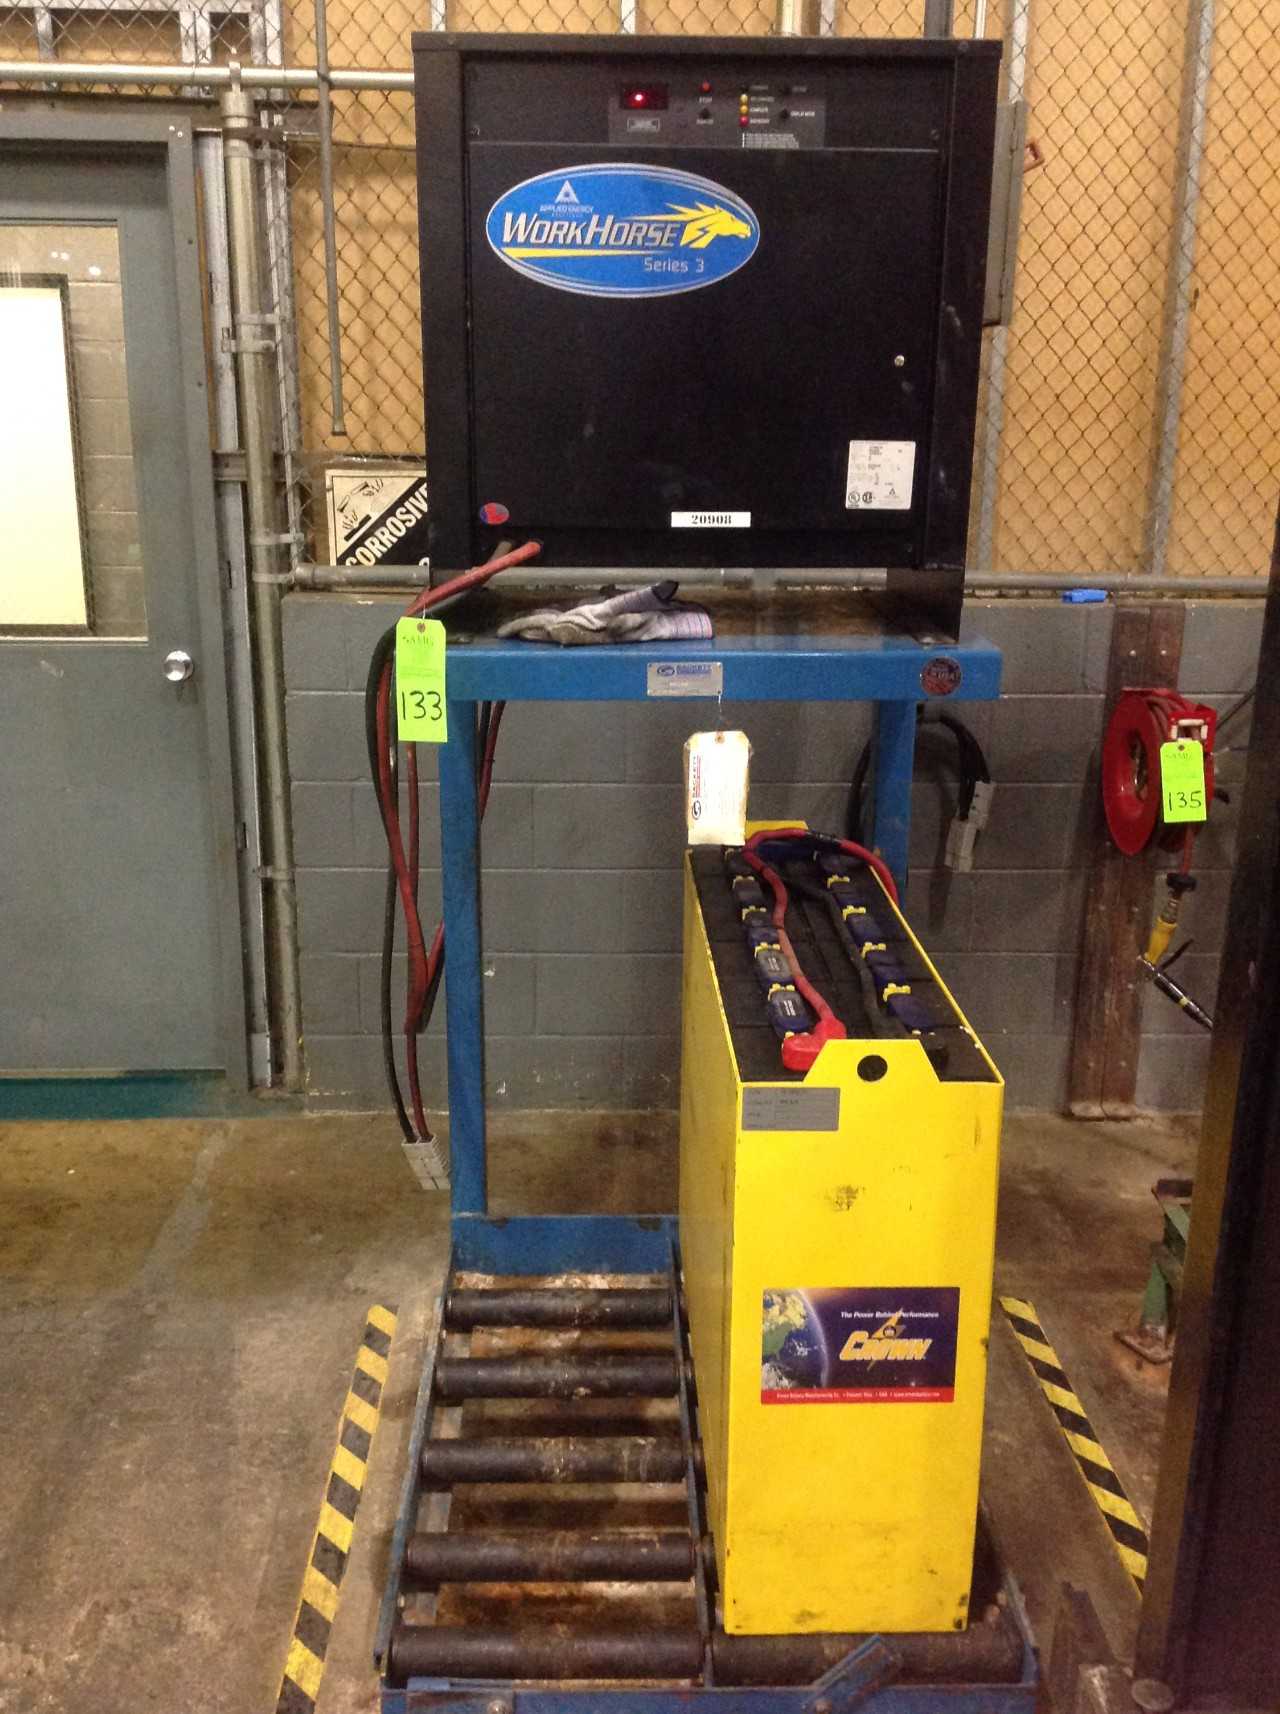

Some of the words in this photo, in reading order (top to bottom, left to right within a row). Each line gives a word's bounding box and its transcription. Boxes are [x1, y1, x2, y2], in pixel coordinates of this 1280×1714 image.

[644, 258, 689, 272] Series
[696, 257, 704, 273] 3
[402, 690, 443, 720] 133
[1168, 791, 1202, 812] 135
